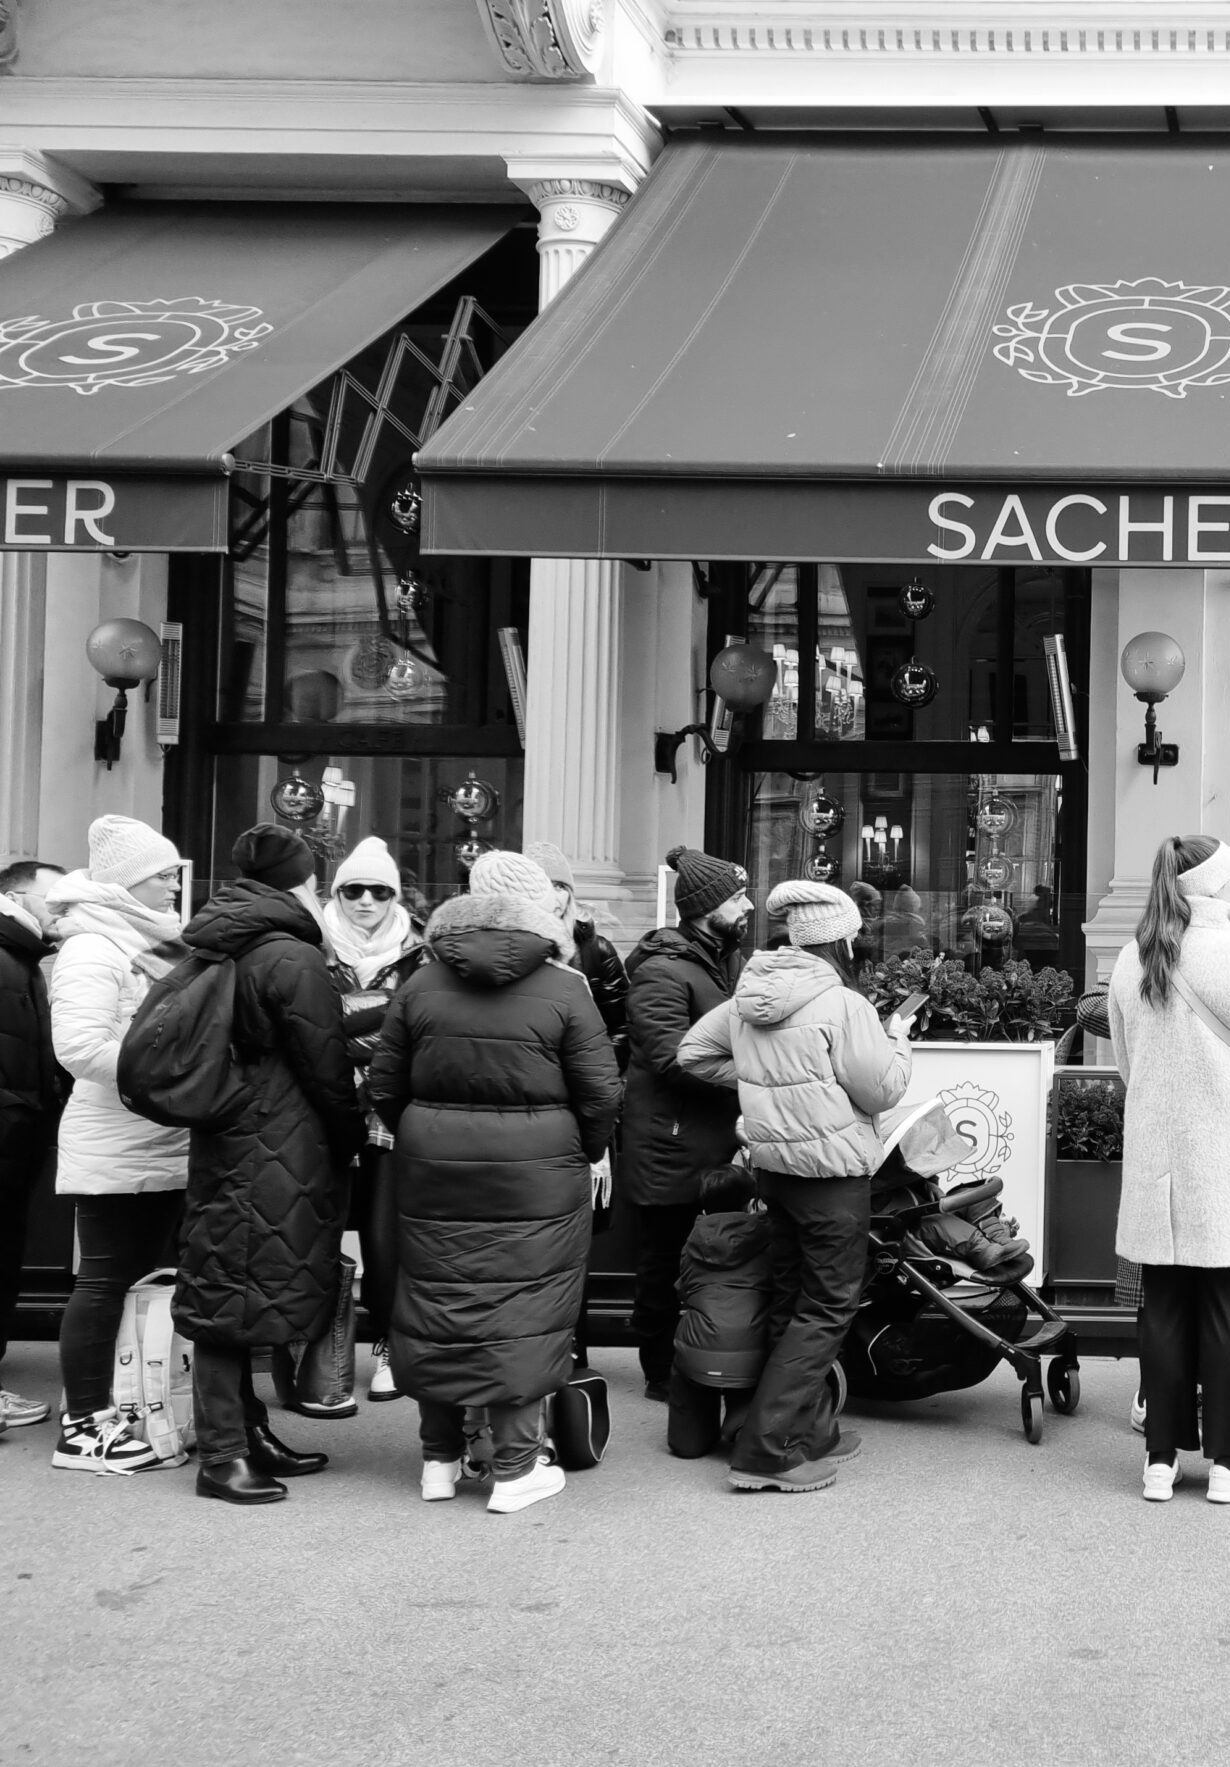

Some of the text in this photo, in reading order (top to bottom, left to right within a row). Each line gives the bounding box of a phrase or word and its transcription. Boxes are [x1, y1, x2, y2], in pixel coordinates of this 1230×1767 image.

[59, 332, 162, 364] S
[1101, 322, 1173, 362] S
[4, 478, 116, 546] ER
